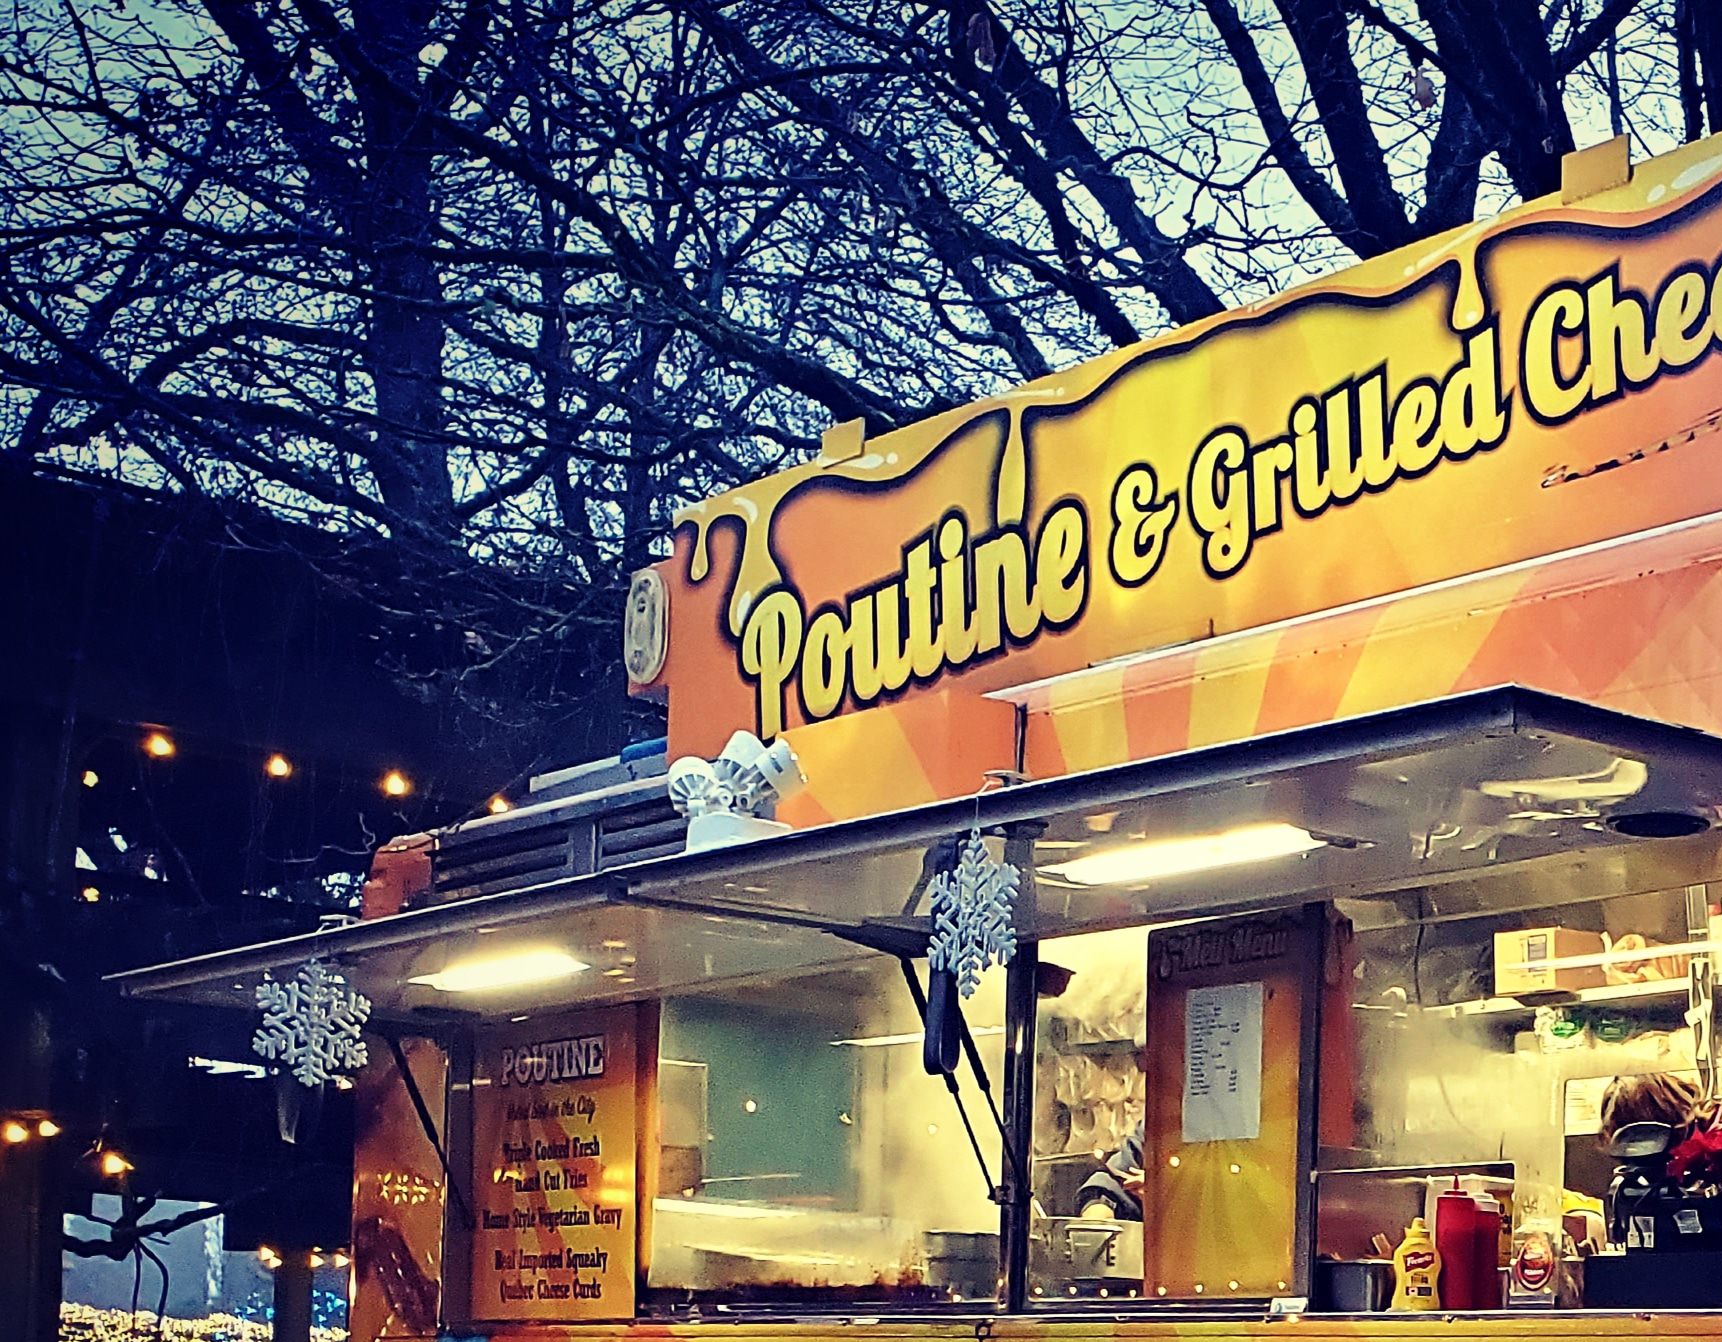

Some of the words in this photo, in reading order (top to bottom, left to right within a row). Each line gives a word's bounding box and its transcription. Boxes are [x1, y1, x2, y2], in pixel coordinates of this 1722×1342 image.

[741, 508, 1090, 732] Poutine
[1110, 468, 1177, 581] &
[1193, 322, 1504, 575] Grilled
[501, 1033, 603, 1087] POUTINE
[577, 1094, 596, 1123] City
[534, 1137, 570, 1161] Cooked
[572, 1135, 600, 1158] Fresh
[543, 1170, 561, 1192] Cut
[563, 1168, 588, 1190] Fries
[482, 1208, 509, 1230] Home
[512, 1207, 536, 1230] Style
[537, 1205, 590, 1233] Vegetarian
[593, 1205, 622, 1230] Gravy
[494, 1249, 516, 1271] Real
[518, 1248, 563, 1275] Imported
[566, 1246, 608, 1275] Squeaky
[537, 1279, 570, 1299] Cheese
[573, 1278, 602, 1299] Curds
